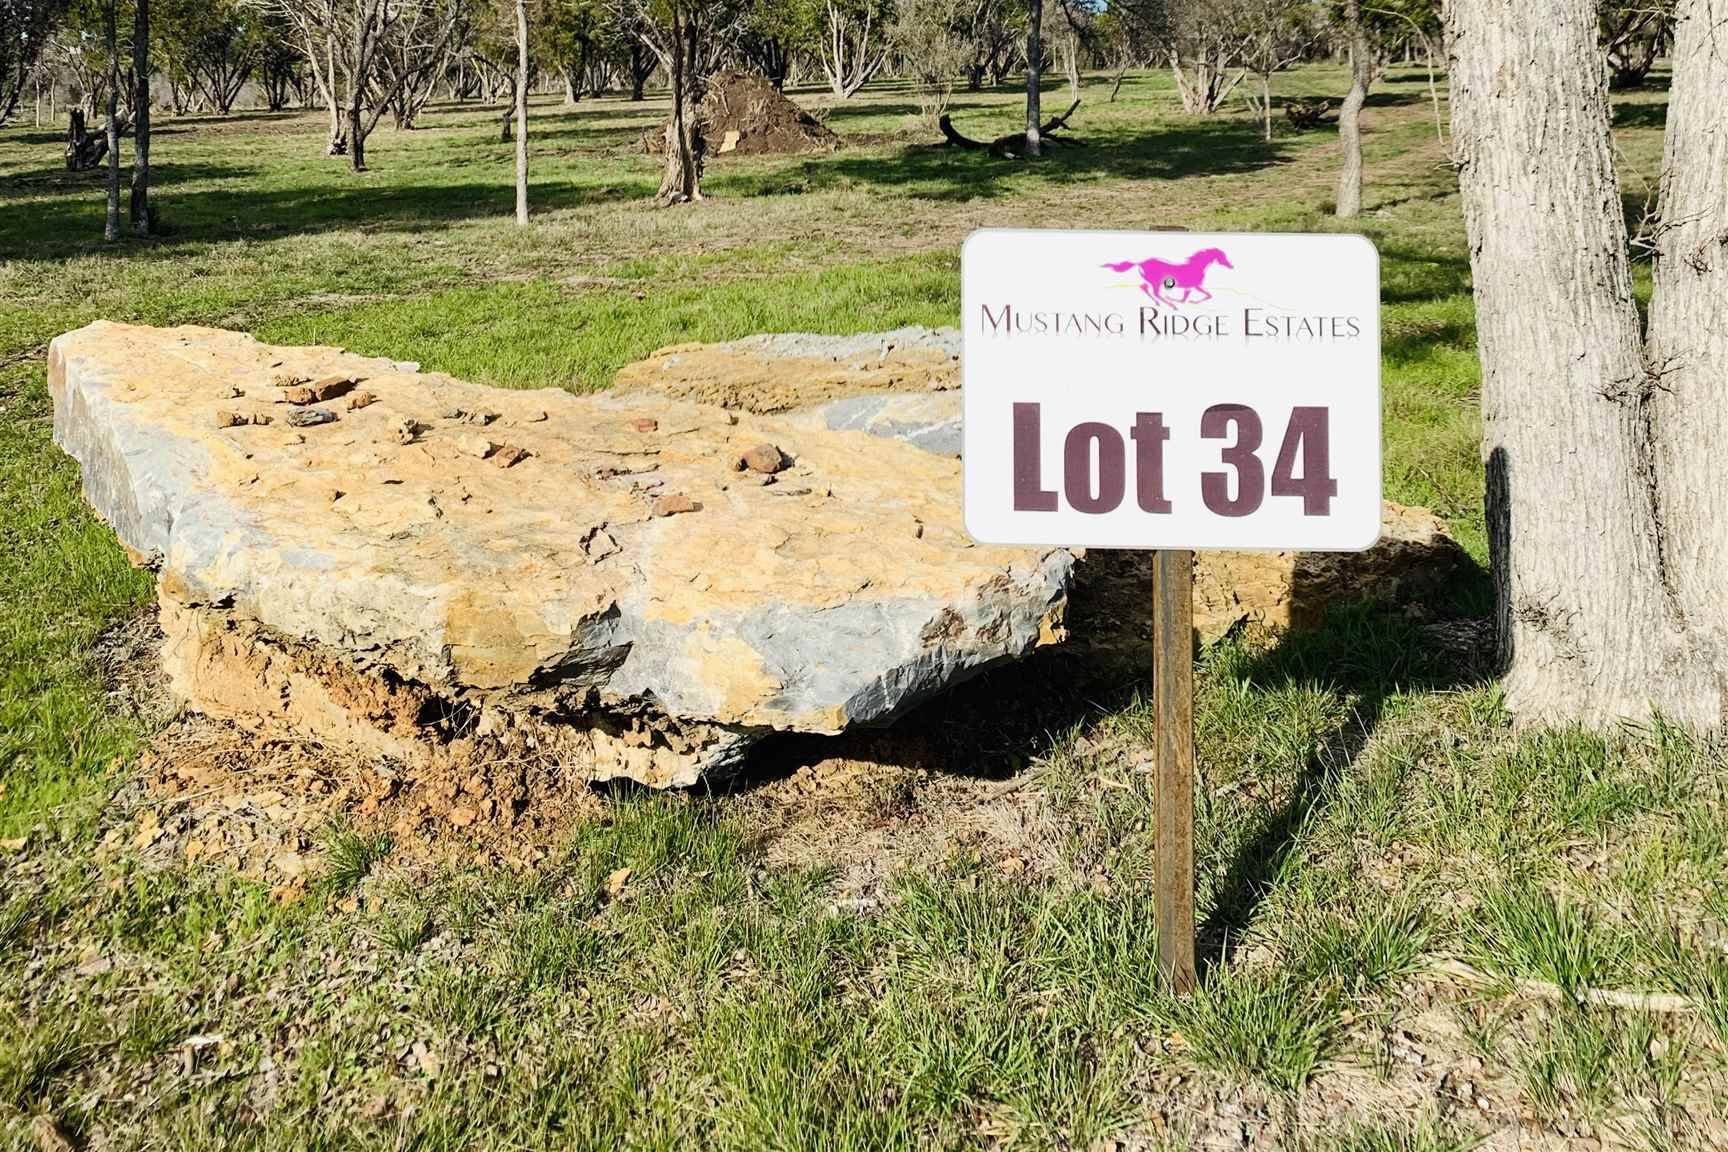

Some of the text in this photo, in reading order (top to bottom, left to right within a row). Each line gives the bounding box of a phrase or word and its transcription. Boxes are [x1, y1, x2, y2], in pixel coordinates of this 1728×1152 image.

[981, 304, 1361, 338] MUSTANG RIDGE ESTATES
[1012, 402, 1338, 518] Lot 34
